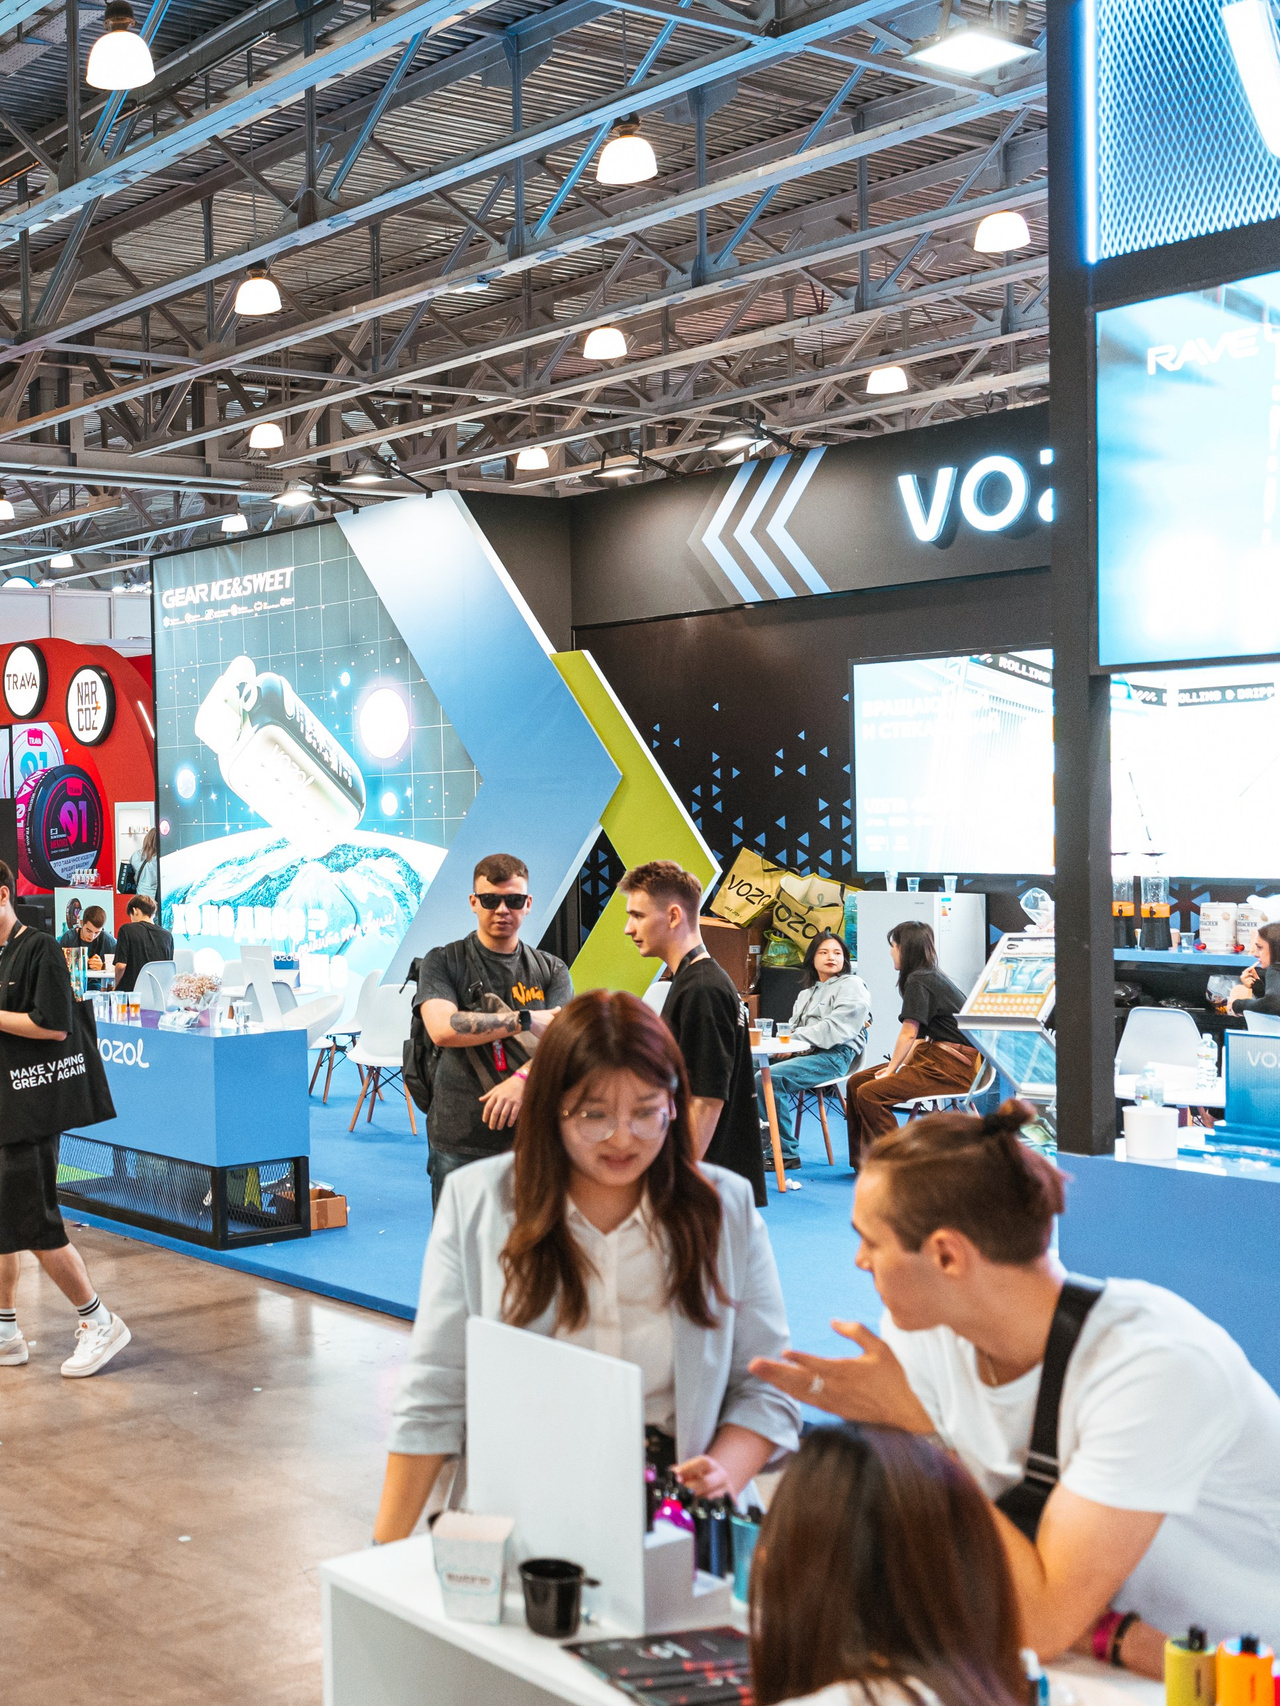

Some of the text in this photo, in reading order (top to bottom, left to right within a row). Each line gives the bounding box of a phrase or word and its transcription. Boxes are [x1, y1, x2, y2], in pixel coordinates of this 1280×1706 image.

[1147, 326, 1260, 376] RAVE
[162, 567, 295, 609] GEAR ICE&SWEET
[6, 671, 39, 692] TRAVA
[77, 680, 98, 706] NAR
[10, 1053, 84, 1080] MAKE VAPING
[12, 1063, 86, 1090] GREAT AGAIN
